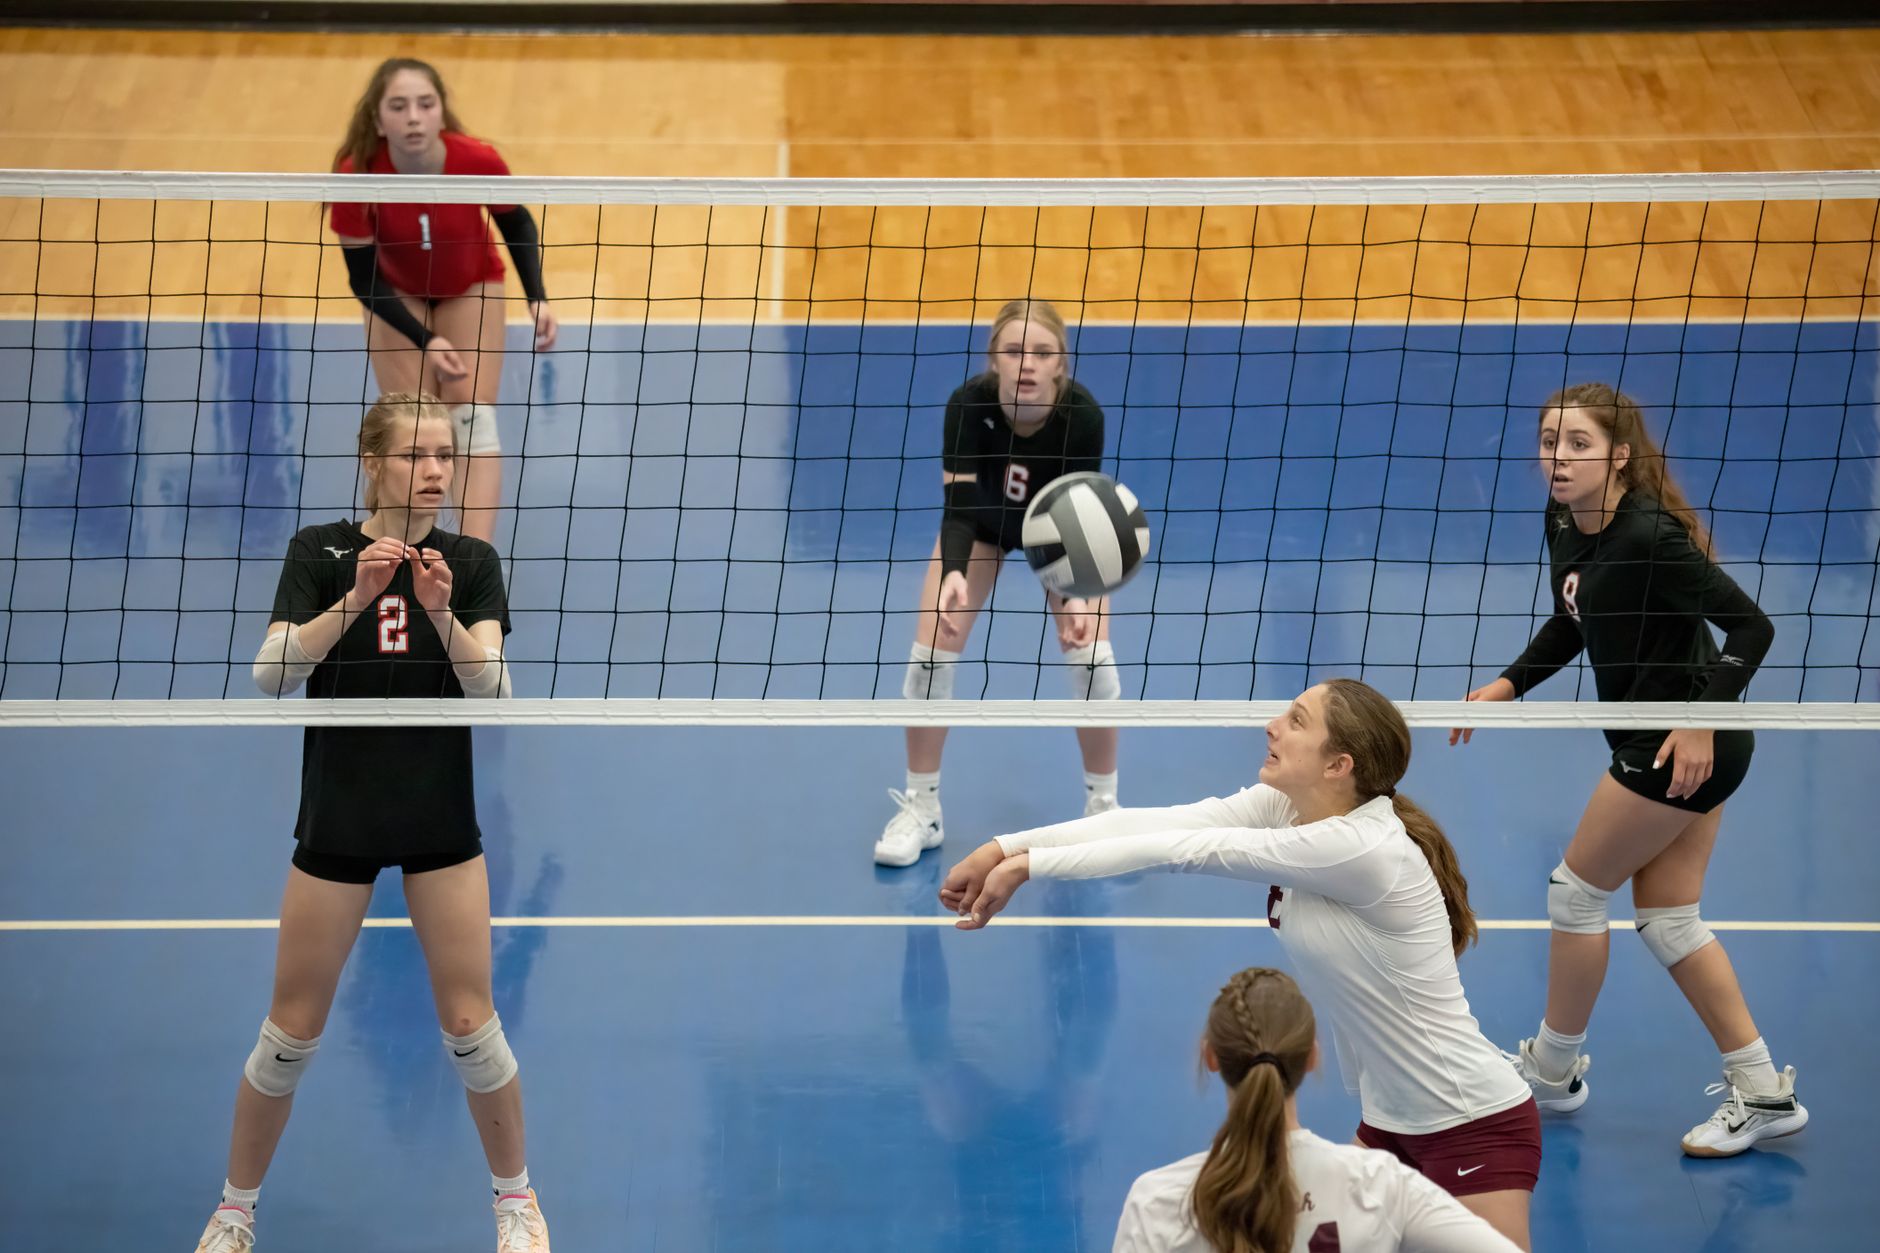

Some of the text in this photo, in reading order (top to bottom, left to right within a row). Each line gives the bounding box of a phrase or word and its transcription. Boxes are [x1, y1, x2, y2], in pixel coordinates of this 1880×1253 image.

[418, 212, 432, 251] 1
[1004, 463, 1029, 502] 6
[377, 594, 409, 653] 2
